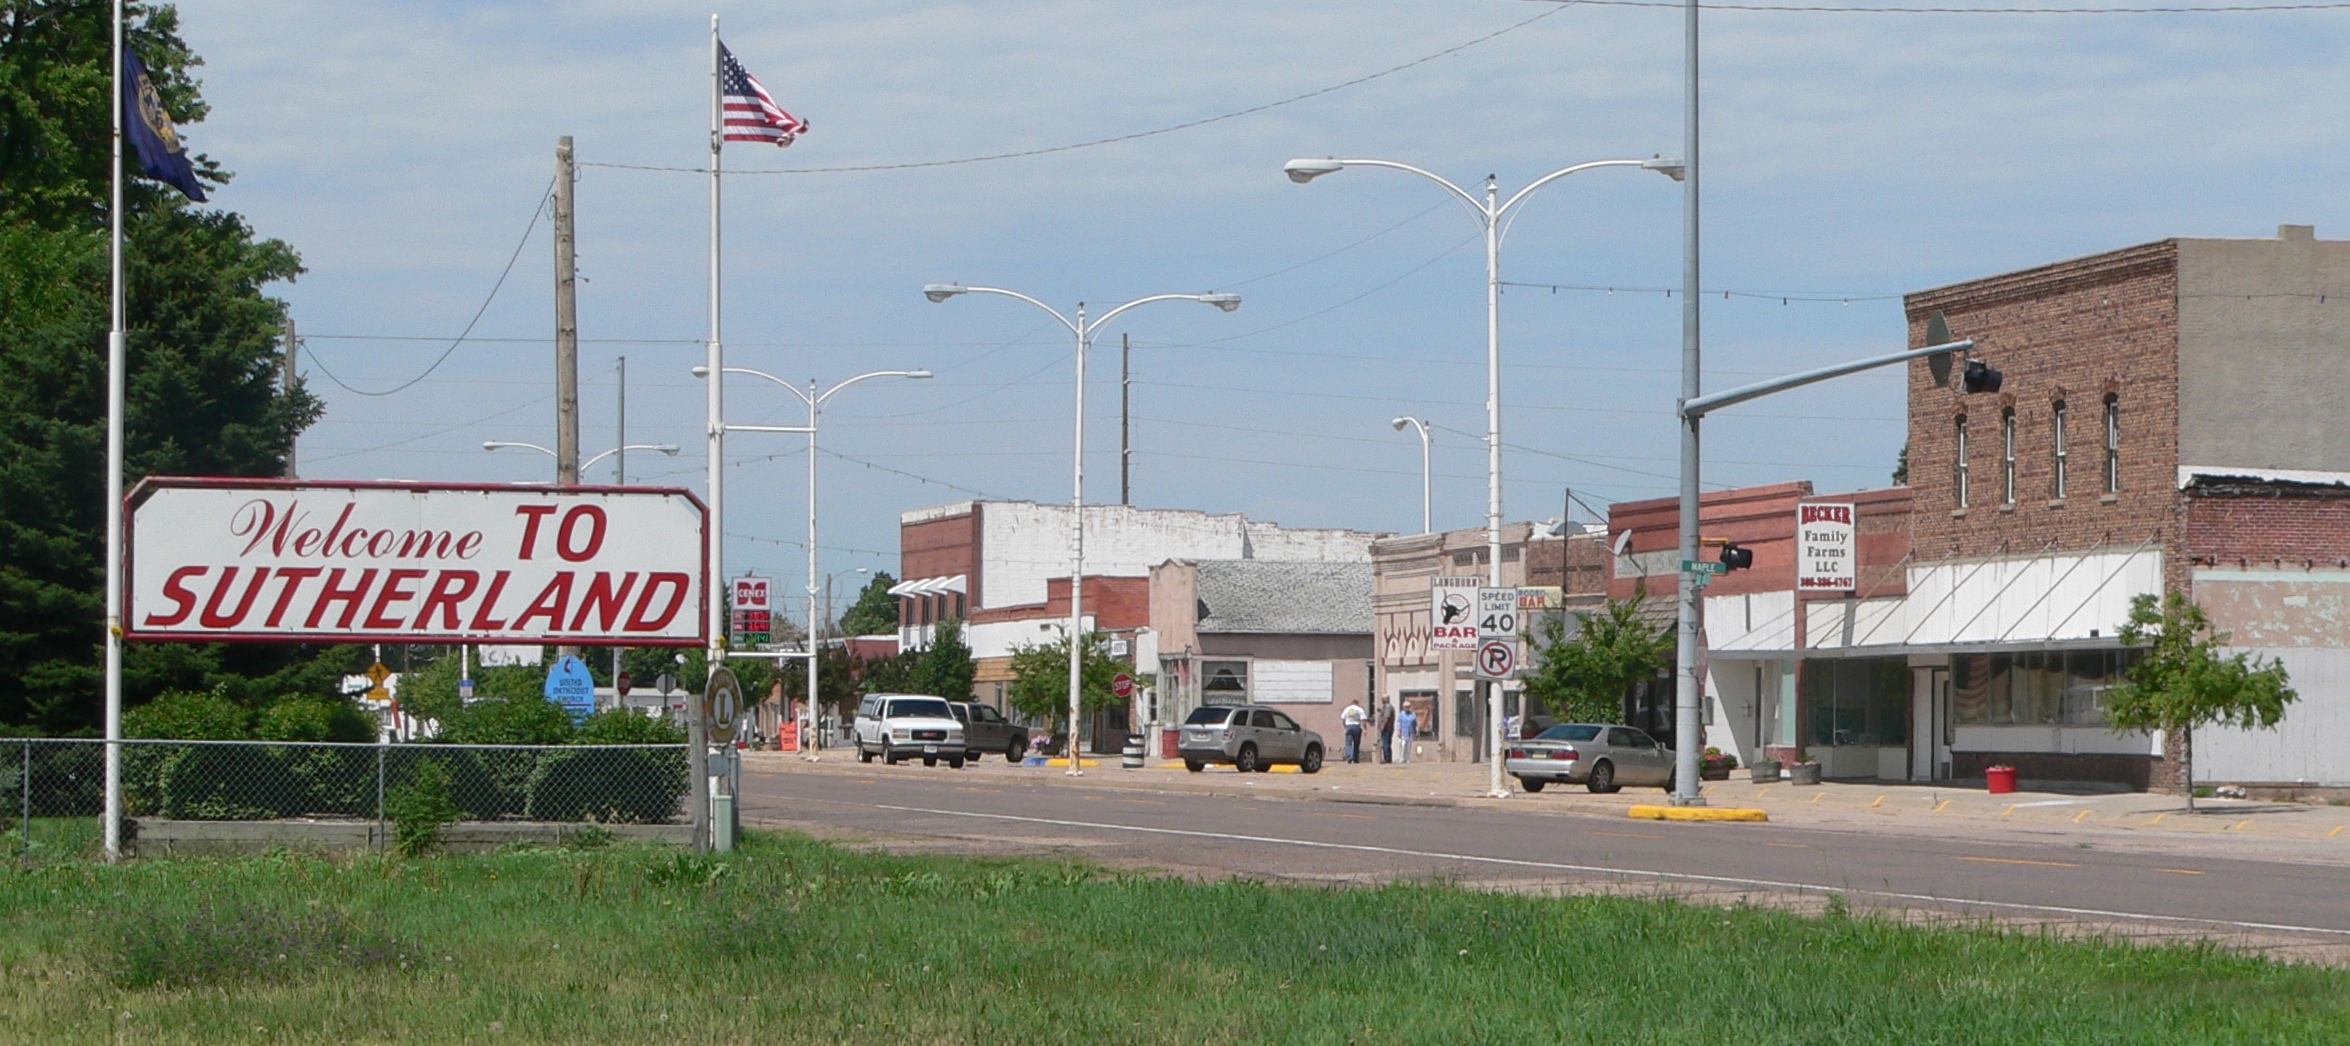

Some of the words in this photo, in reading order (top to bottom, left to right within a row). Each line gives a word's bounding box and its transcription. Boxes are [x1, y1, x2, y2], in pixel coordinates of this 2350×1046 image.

[1801, 506, 1852, 525] BECKER
[230, 499, 484, 560] Welcome
[515, 504, 608, 562] TO
[1804, 530, 1848, 545] Family
[1807, 546, 1846, 557] Farms
[1691, 562, 1716, 573] MAPLE
[1815, 561, 1838, 572] LLC
[143, 564, 691, 633] SUTHERLAND
[738, 588, 766, 598] CENEX
[1481, 592, 1515, 601] SPEED
[1517, 589, 1546, 597] RODEO
[1484, 603, 1511, 611] LIMIT
[1519, 597, 1546, 607] BAR
[1481, 613, 1515, 632] 40
[1433, 627, 1477, 638] BAR
[1113, 679, 1132, 691] STOP
[719, 693, 730, 724] L
